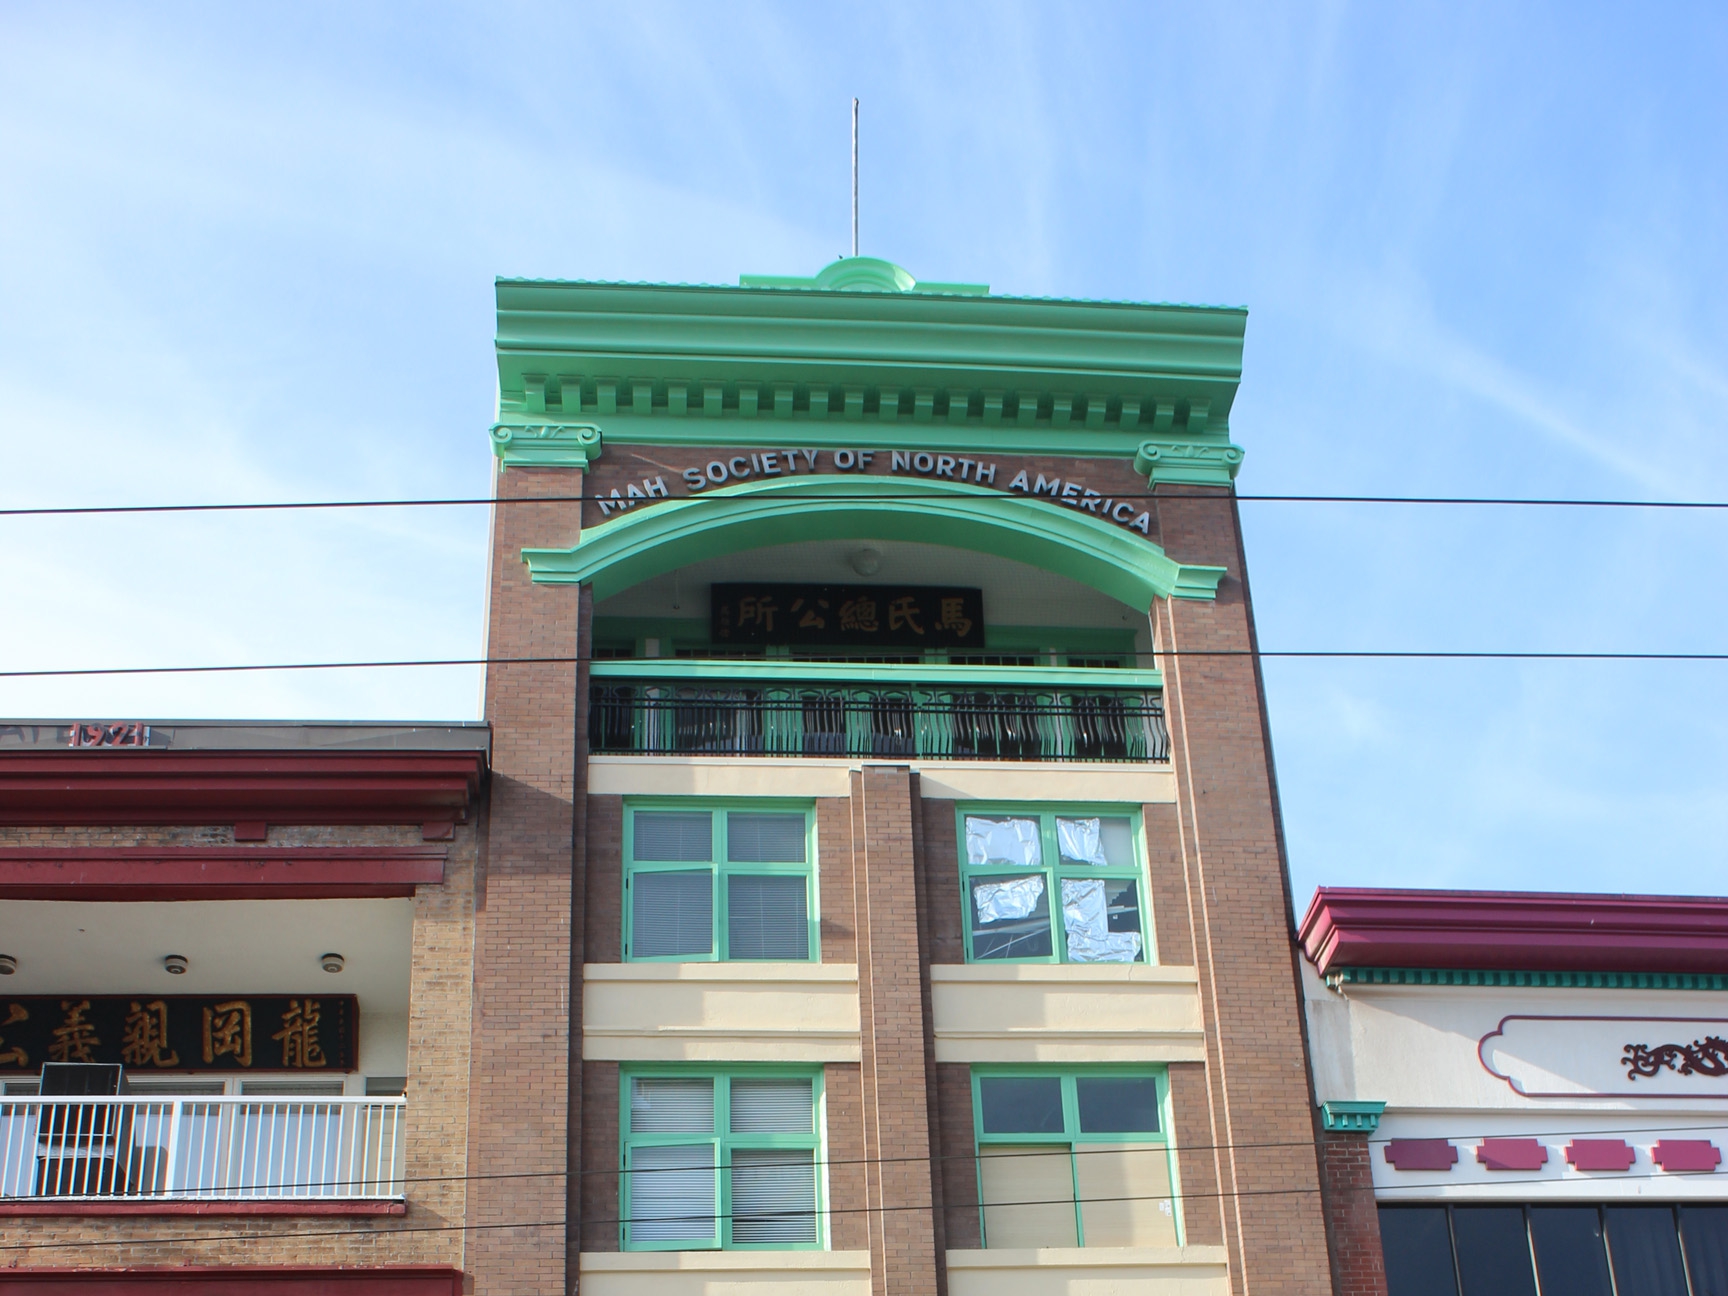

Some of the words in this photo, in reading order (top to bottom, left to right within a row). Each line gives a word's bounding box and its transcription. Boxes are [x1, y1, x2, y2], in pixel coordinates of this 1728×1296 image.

[596, 475, 669, 516] MAH
[682, 448, 819, 491] SOCIETY
[833, 449, 875, 470] OF
[892, 450, 996, 484] NORTH
[1009, 469, 1151, 535] AMERICA
[71, 721, 146, 747] 1921
